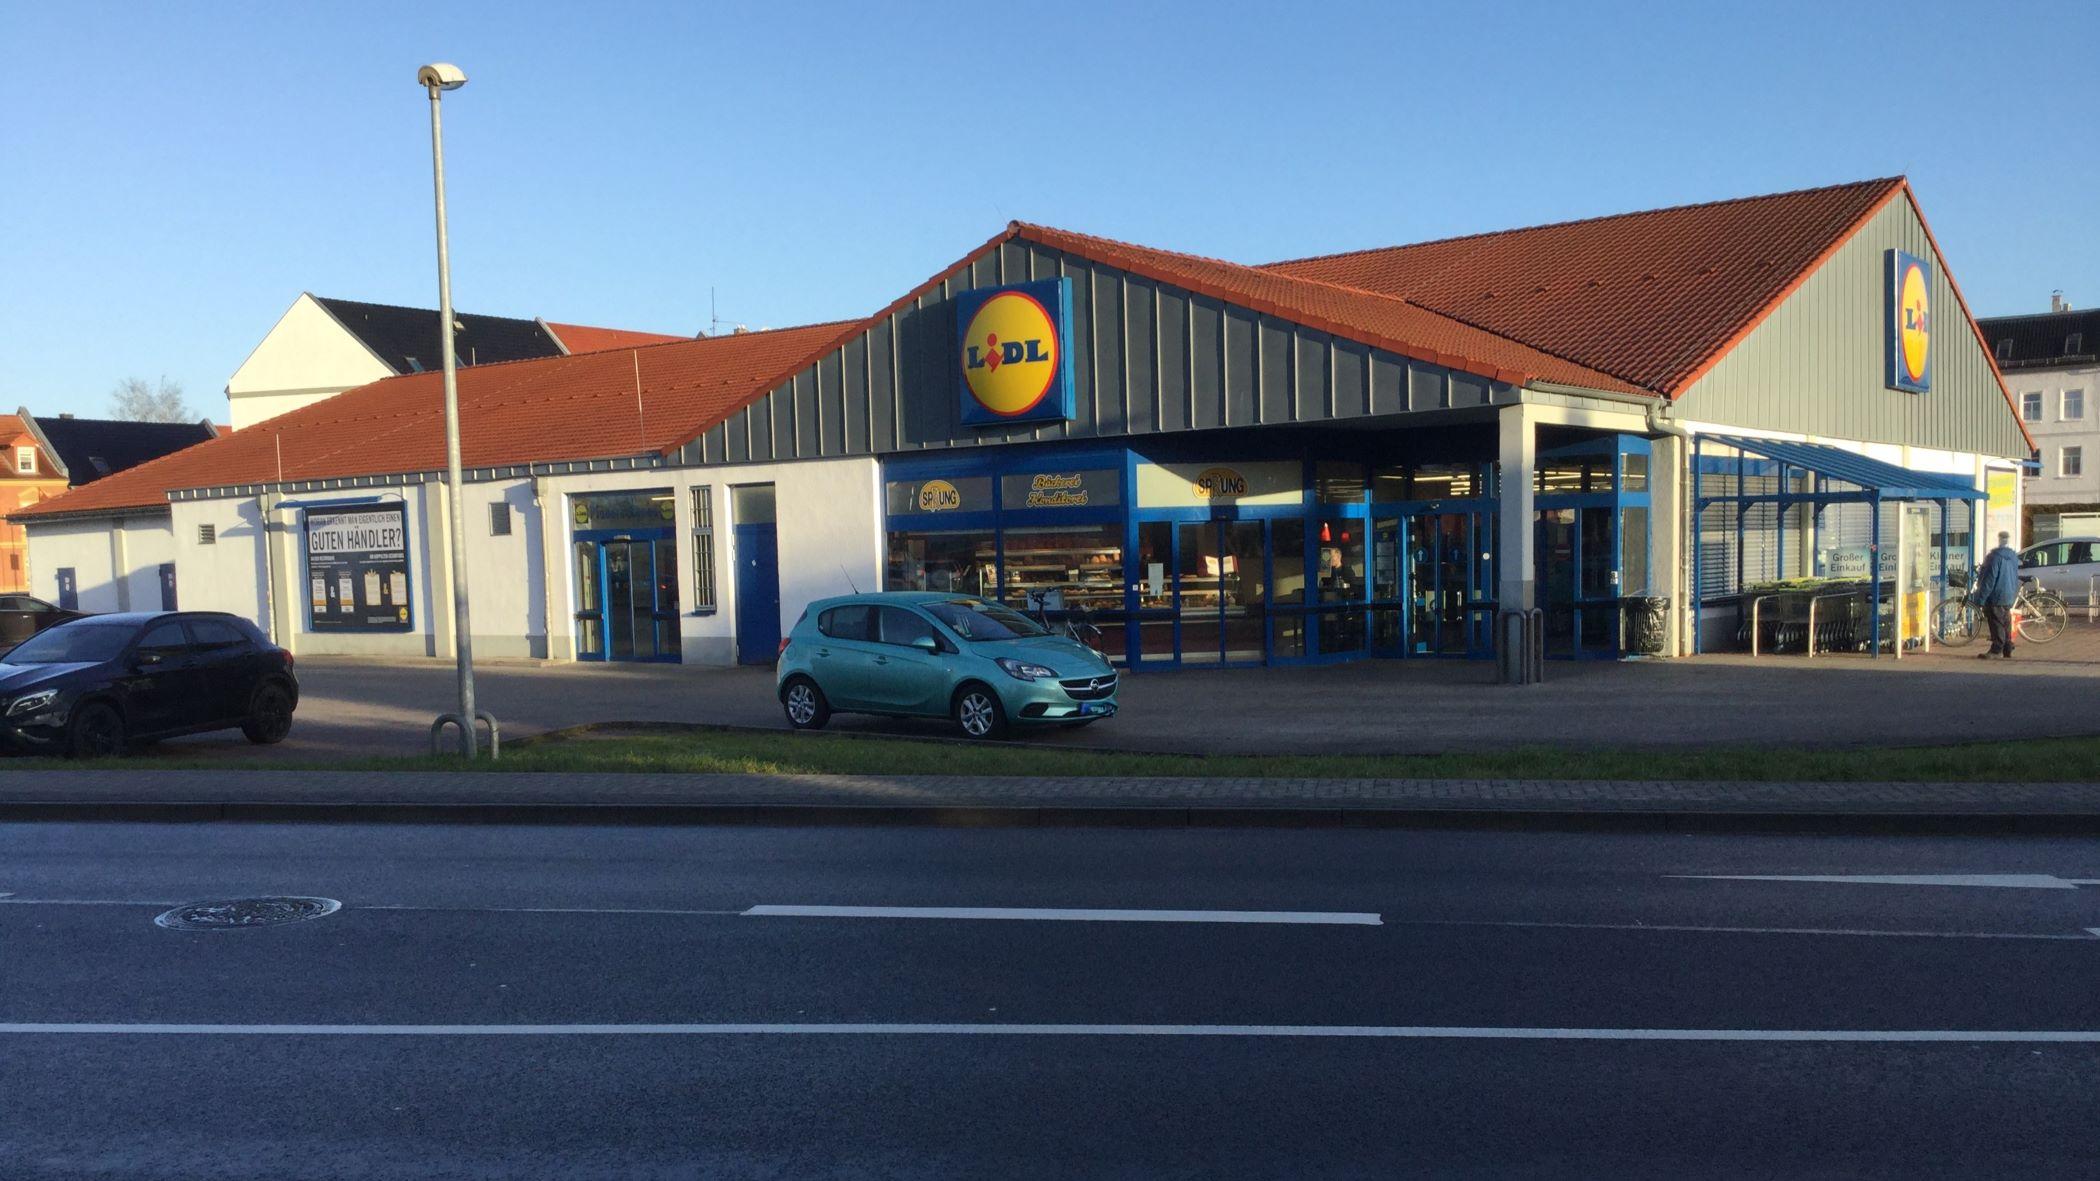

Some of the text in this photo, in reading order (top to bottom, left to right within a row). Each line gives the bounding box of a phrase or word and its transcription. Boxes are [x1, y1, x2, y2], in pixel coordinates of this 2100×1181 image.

[1027, 491, 1087, 506] Konditorei
[348, 515, 358, 524] MAN
[359, 514, 385, 524] EIGENTLICH
[386, 513, 400, 522] EINEN
[311, 525, 401, 550] GUTEN HÄNDLER?
[1832, 553, 1864, 562] Großer
[1880, 553, 1896, 562] Gro
[1830, 563, 1866, 572] Einkauf
